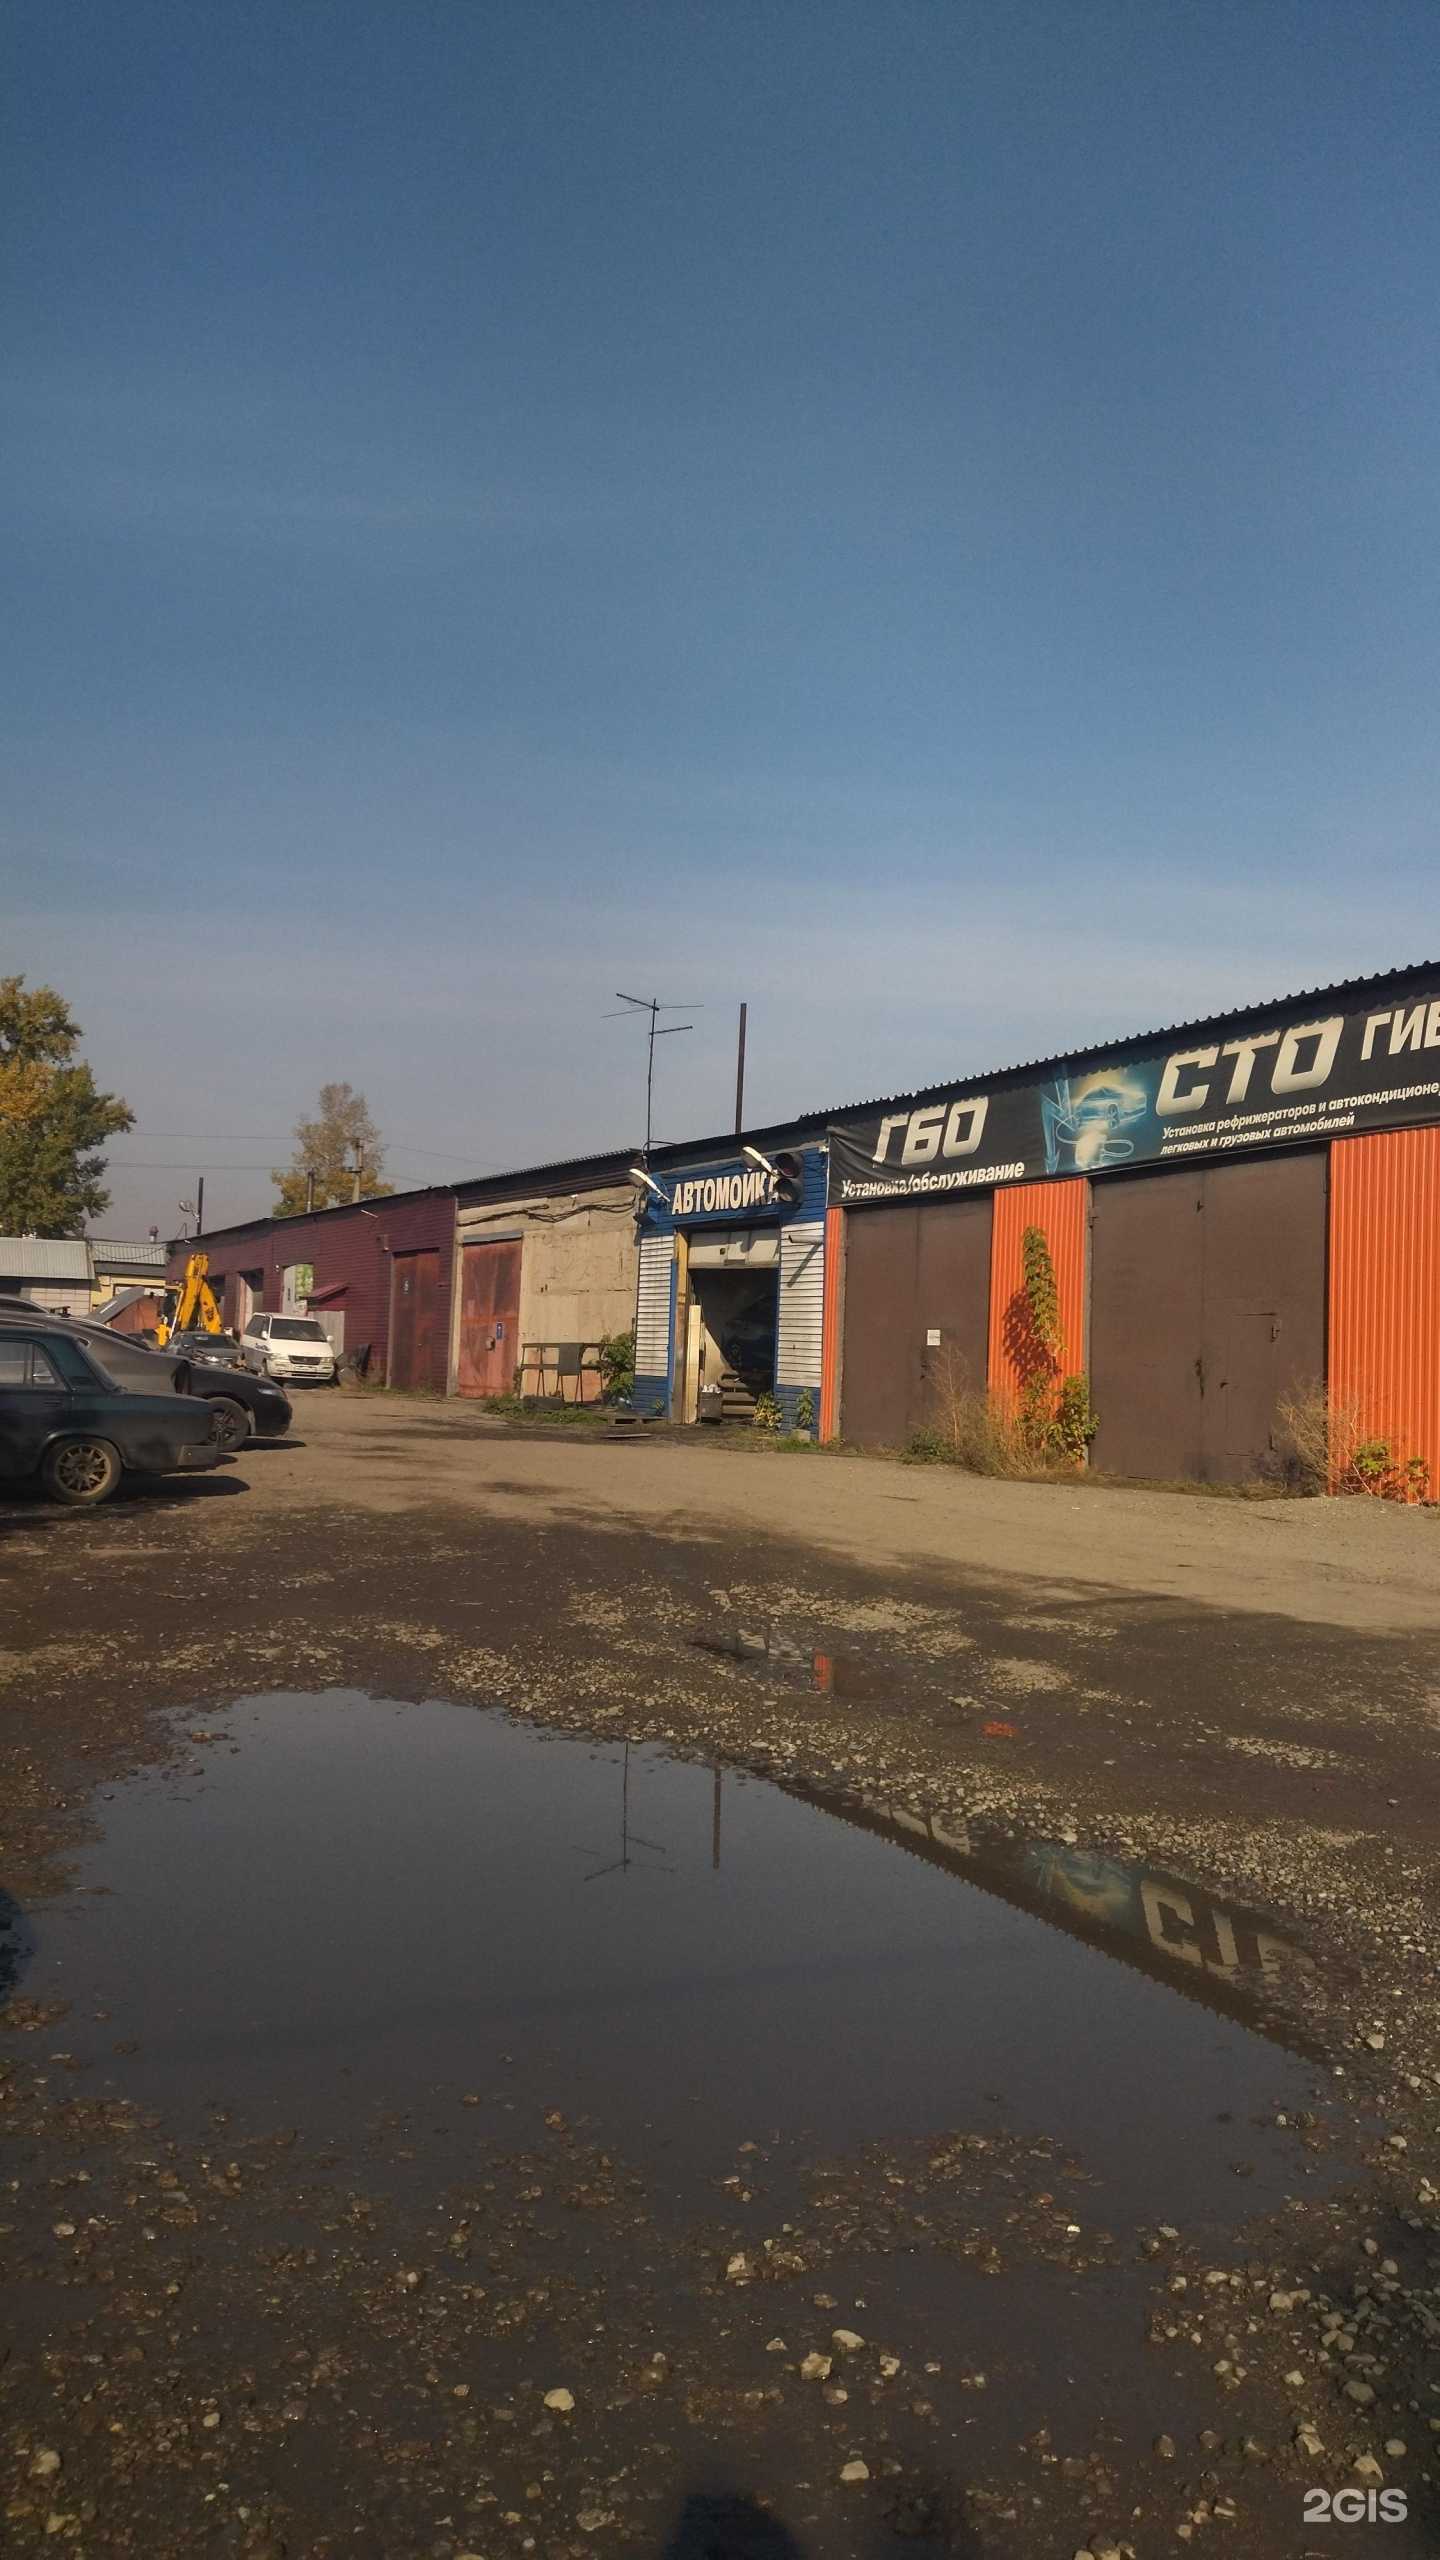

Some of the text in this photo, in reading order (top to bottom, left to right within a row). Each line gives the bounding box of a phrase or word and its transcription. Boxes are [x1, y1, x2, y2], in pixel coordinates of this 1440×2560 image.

[1156, 1015, 1344, 1116] СТО
[873, 1096, 989, 1166] ГБО
[1160, 1112, 1355, 1155] легковых и грузовых автомобилей
[1162, 1082, 1440, 1139] Установка рефрижераторов и автокондиционе
[841, 1161, 1025, 1198] Установка/обслуживание
